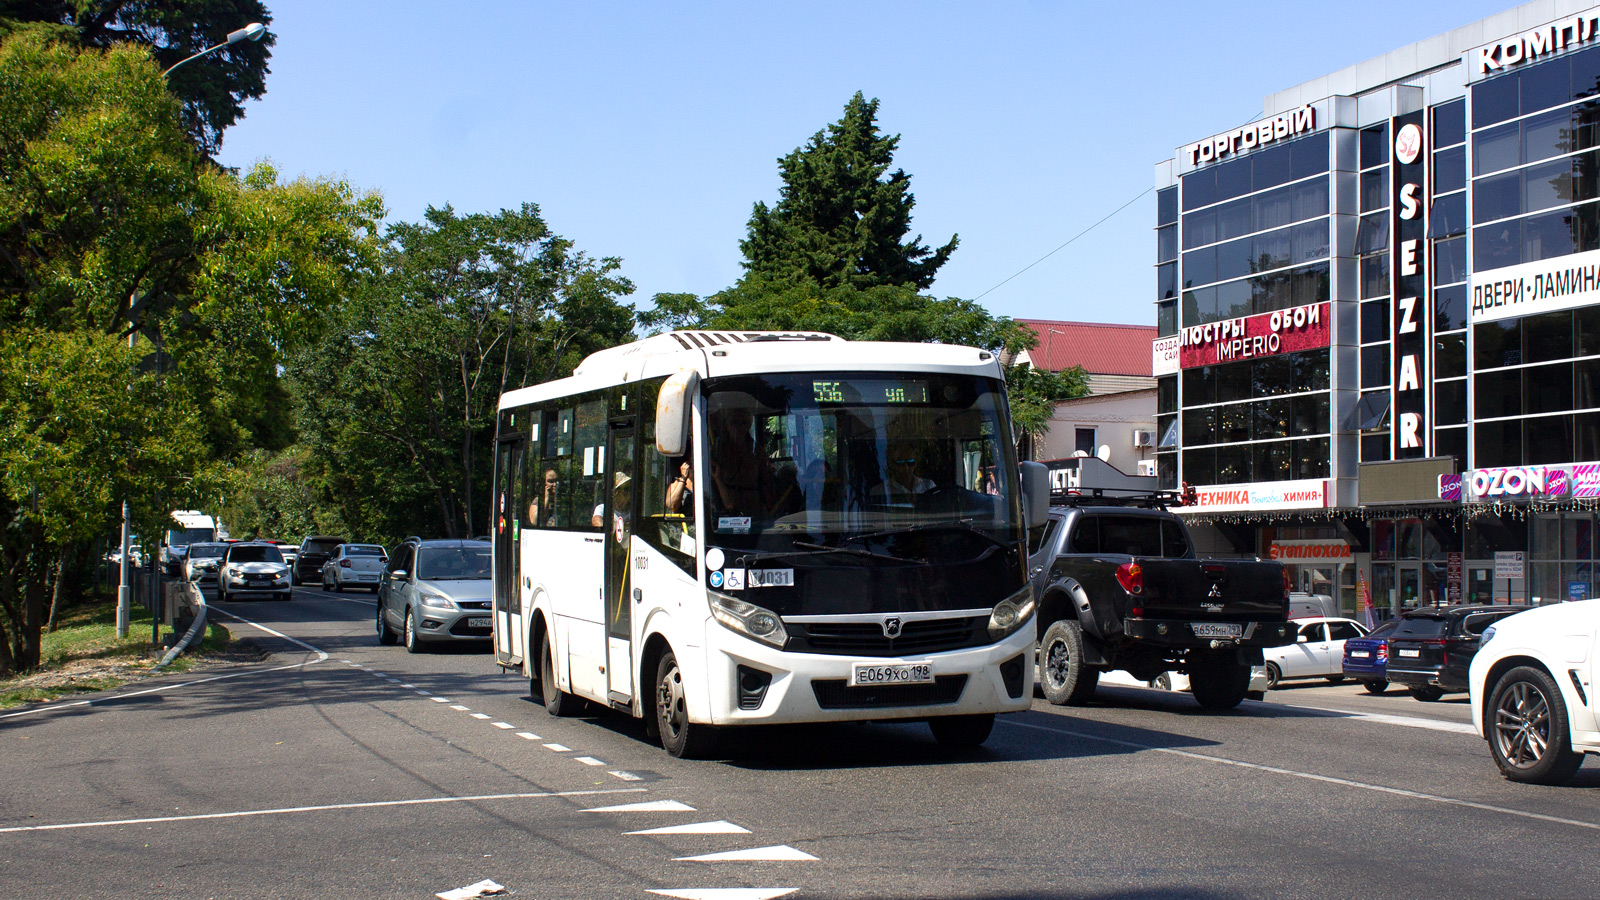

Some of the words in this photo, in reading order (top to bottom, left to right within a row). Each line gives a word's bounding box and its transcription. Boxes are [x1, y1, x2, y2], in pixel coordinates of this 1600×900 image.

[1186, 104, 1313, 165] ТОРГОВЫЙ
[1180, 317, 1246, 348] ЛЮСТРЫ
[1270, 304, 1320, 332] ОБОИ
[1399, 183, 1419, 448] SEZAR
[1216, 333, 1280, 360] IMPERIO
[1049, 468, 1080, 492] КТЫ
[1472, 469, 1545, 496] OZON
[1549, 475, 1566, 489] OZON
[635, 556, 649, 570] 10031
[860, 667, 909, 682] Е069ХО
[911, 665, 929, 676] 198
